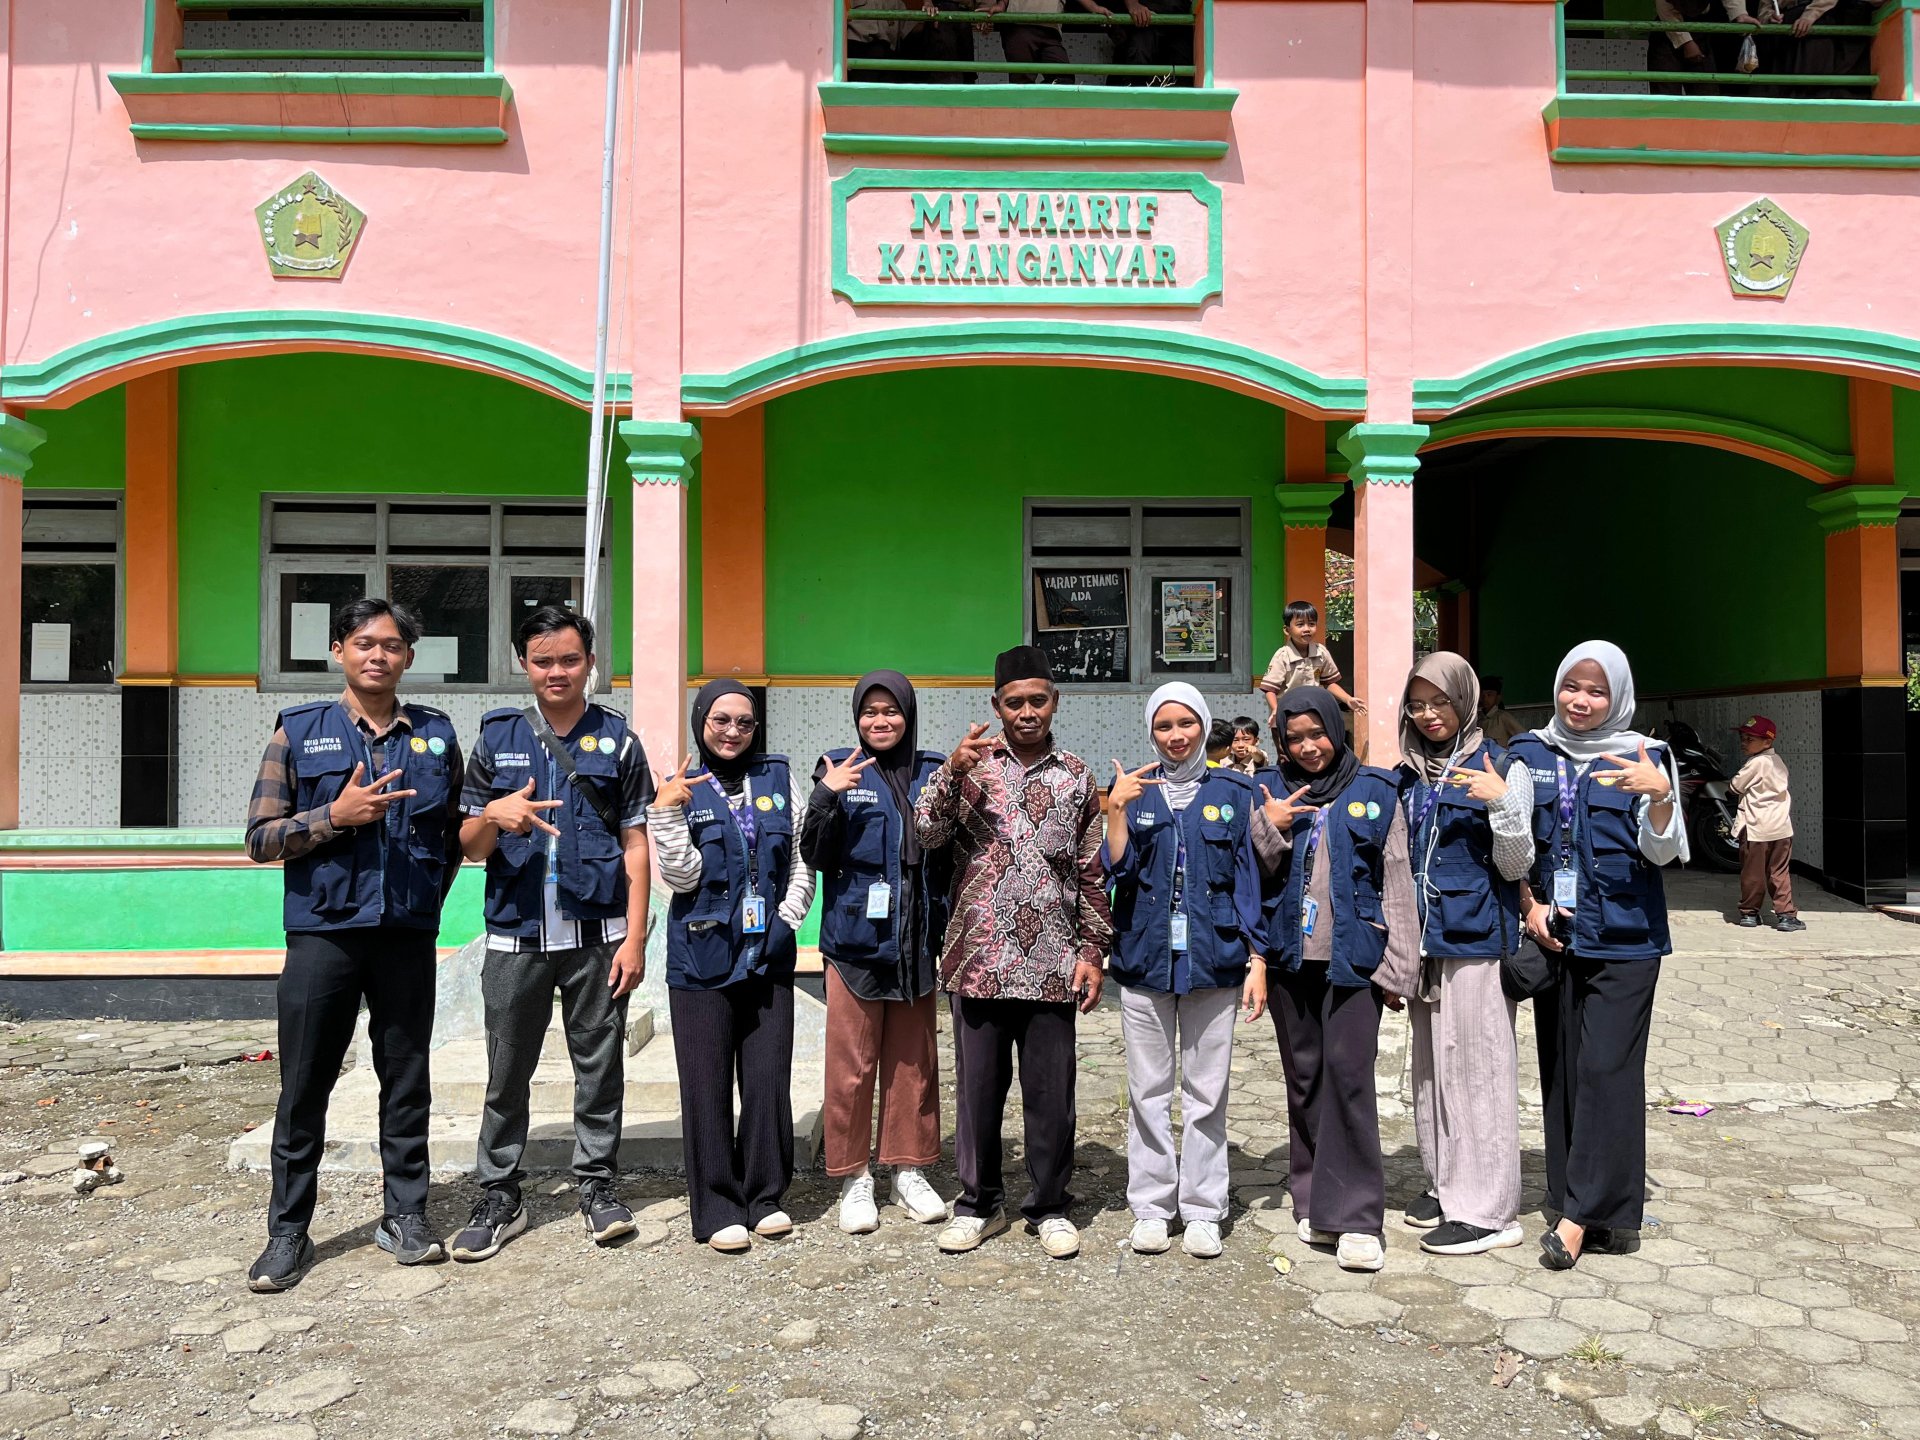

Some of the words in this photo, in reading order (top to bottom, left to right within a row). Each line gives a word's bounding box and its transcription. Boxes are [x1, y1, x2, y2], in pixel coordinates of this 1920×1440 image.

[910, 193, 1159, 233] MI-MA'ARIF
[878, 243, 1177, 283] KARANGANYAR
[1080, 574, 1119, 588] TENANG
[1071, 591, 1092, 602] ADA
[304, 744, 342, 754] KORMADES
[847, 795, 878, 803] PENDIDIKAN
